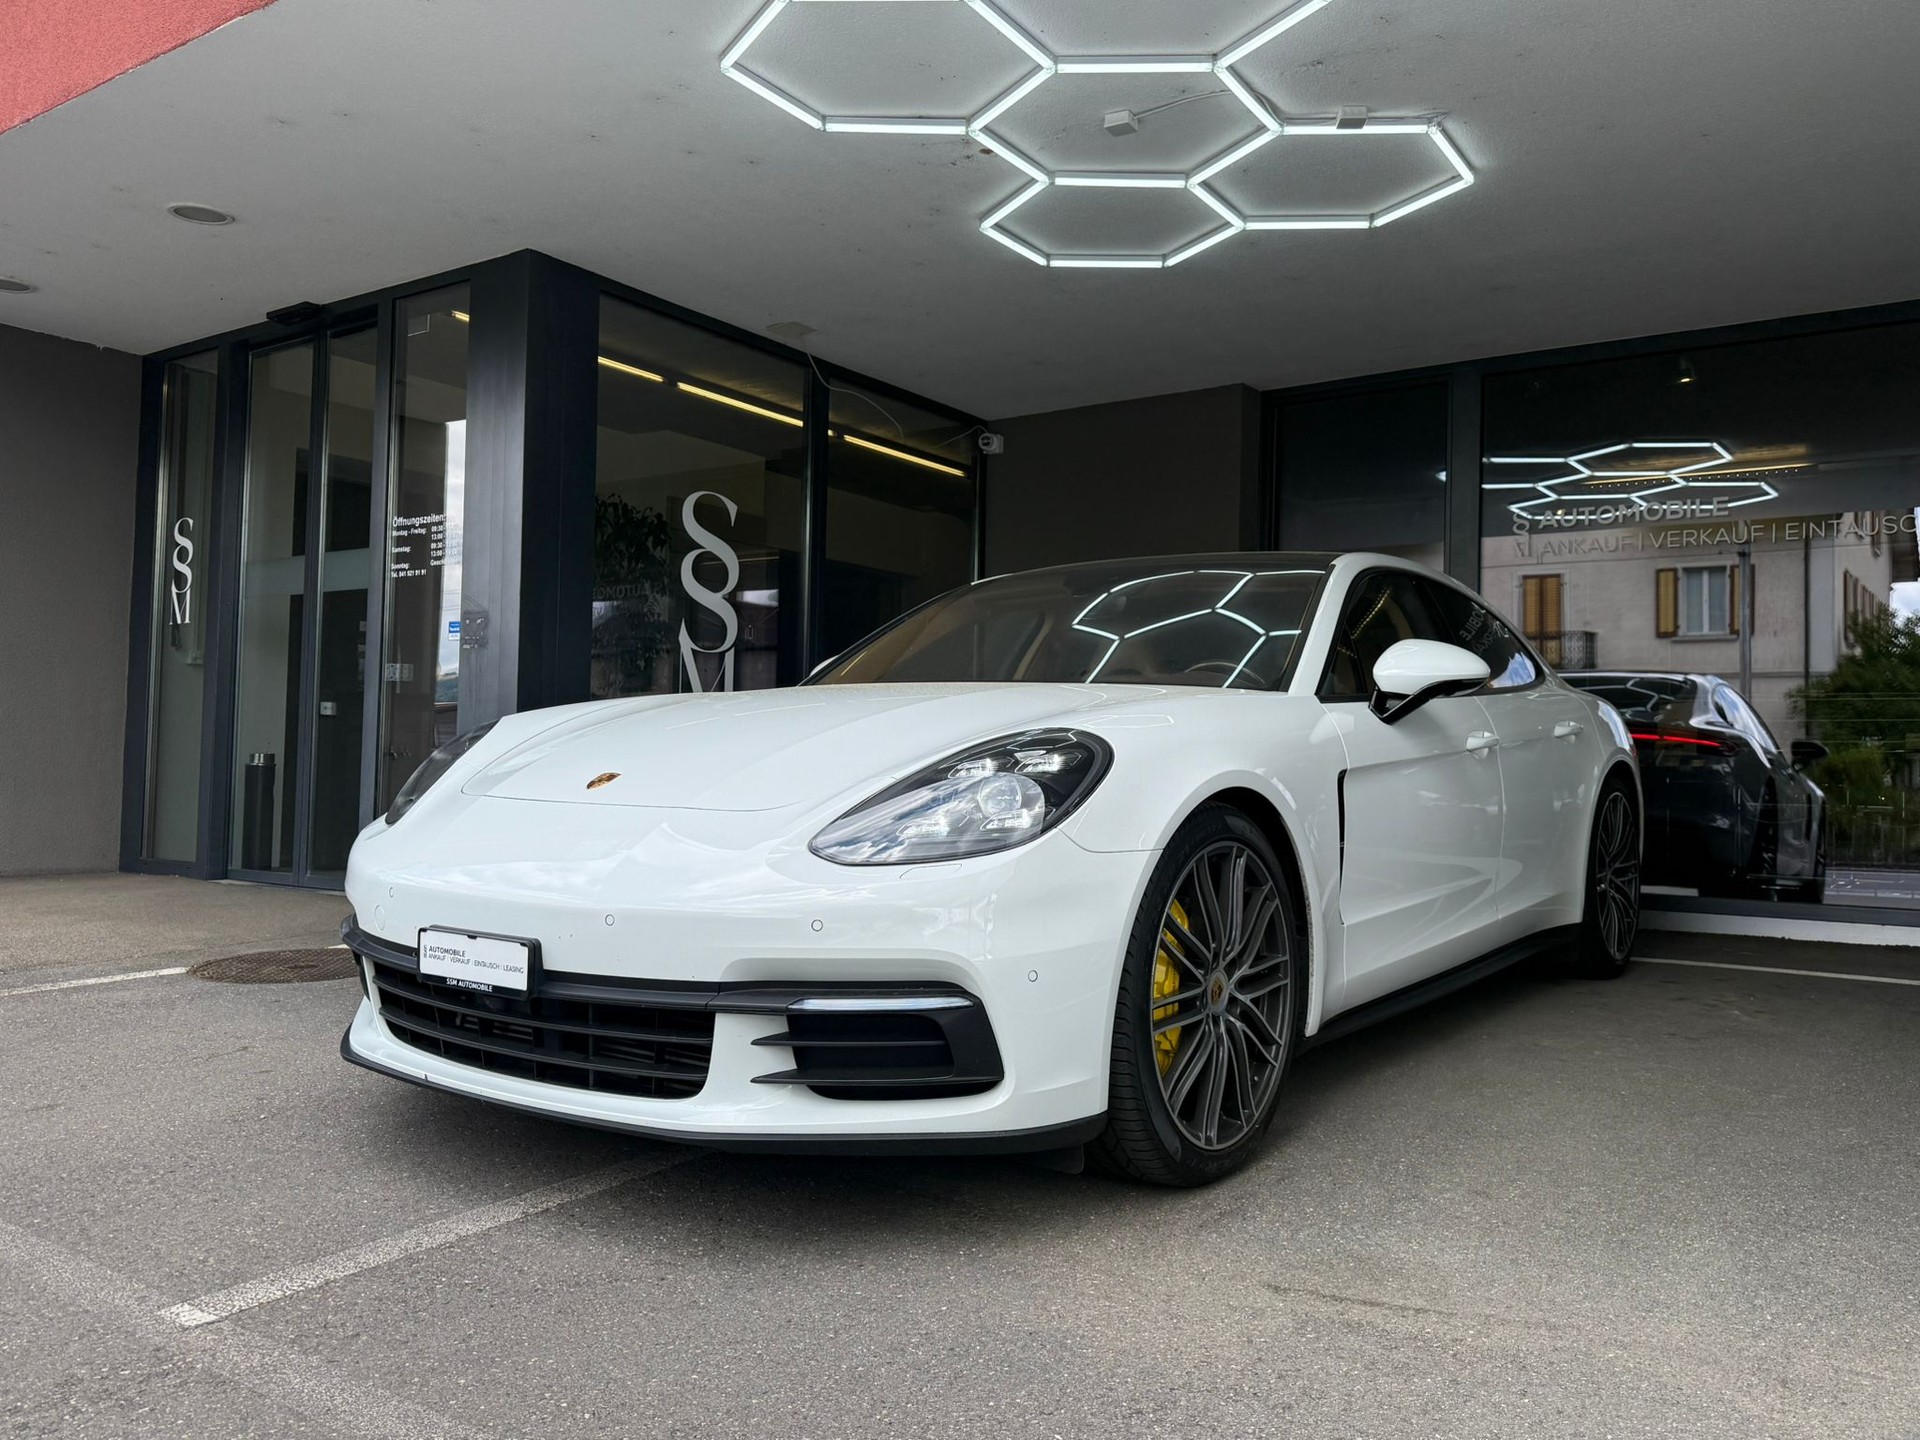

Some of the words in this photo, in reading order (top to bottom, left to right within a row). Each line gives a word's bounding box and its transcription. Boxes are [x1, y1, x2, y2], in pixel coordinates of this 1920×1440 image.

[1538, 496, 1729, 529] AUTOMOBILE
[1541, 532, 1634, 557] ANKAUF
[1650, 524, 1765, 549] VERKAUF
[169, 517, 194, 625] SSM
[428, 945, 466, 958] AUTOMOBILE
[428, 952, 447, 961] ANKAUF
[450, 955, 471, 966] VERKAUF
[474, 959, 500, 970] EINTAUSCH
[503, 964, 524, 974] LEASING
[446, 977, 458, 987] SSM
[458, 980, 493, 992] AUTOMOBILE
